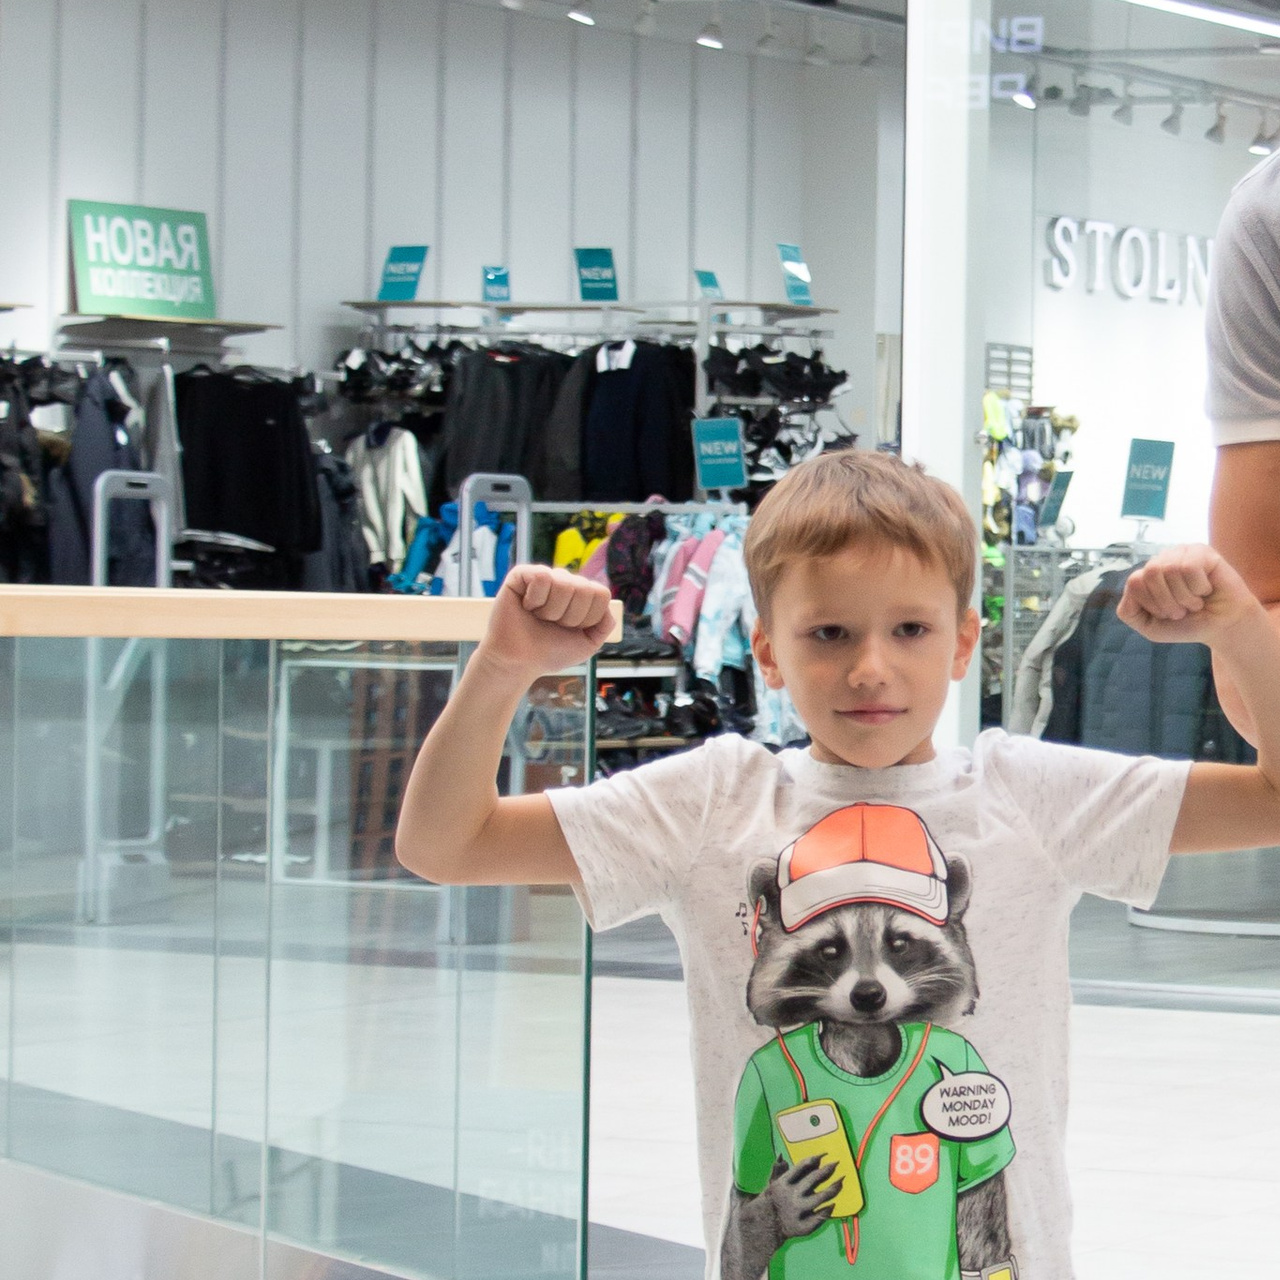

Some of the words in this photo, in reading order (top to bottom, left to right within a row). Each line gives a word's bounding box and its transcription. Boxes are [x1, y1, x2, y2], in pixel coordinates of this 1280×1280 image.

[84, 214, 201, 271] НОВАЯ
[1049, 216, 1215, 307] STOLN
[700, 441, 739, 456] NEW
[1128, 463, 1169, 481] NEW
[940, 1083, 997, 1099] WARNING
[941, 1097, 997, 1113] MONDAY
[947, 1112, 992, 1128] MOOD!
[895, 1143, 935, 1176] 89
